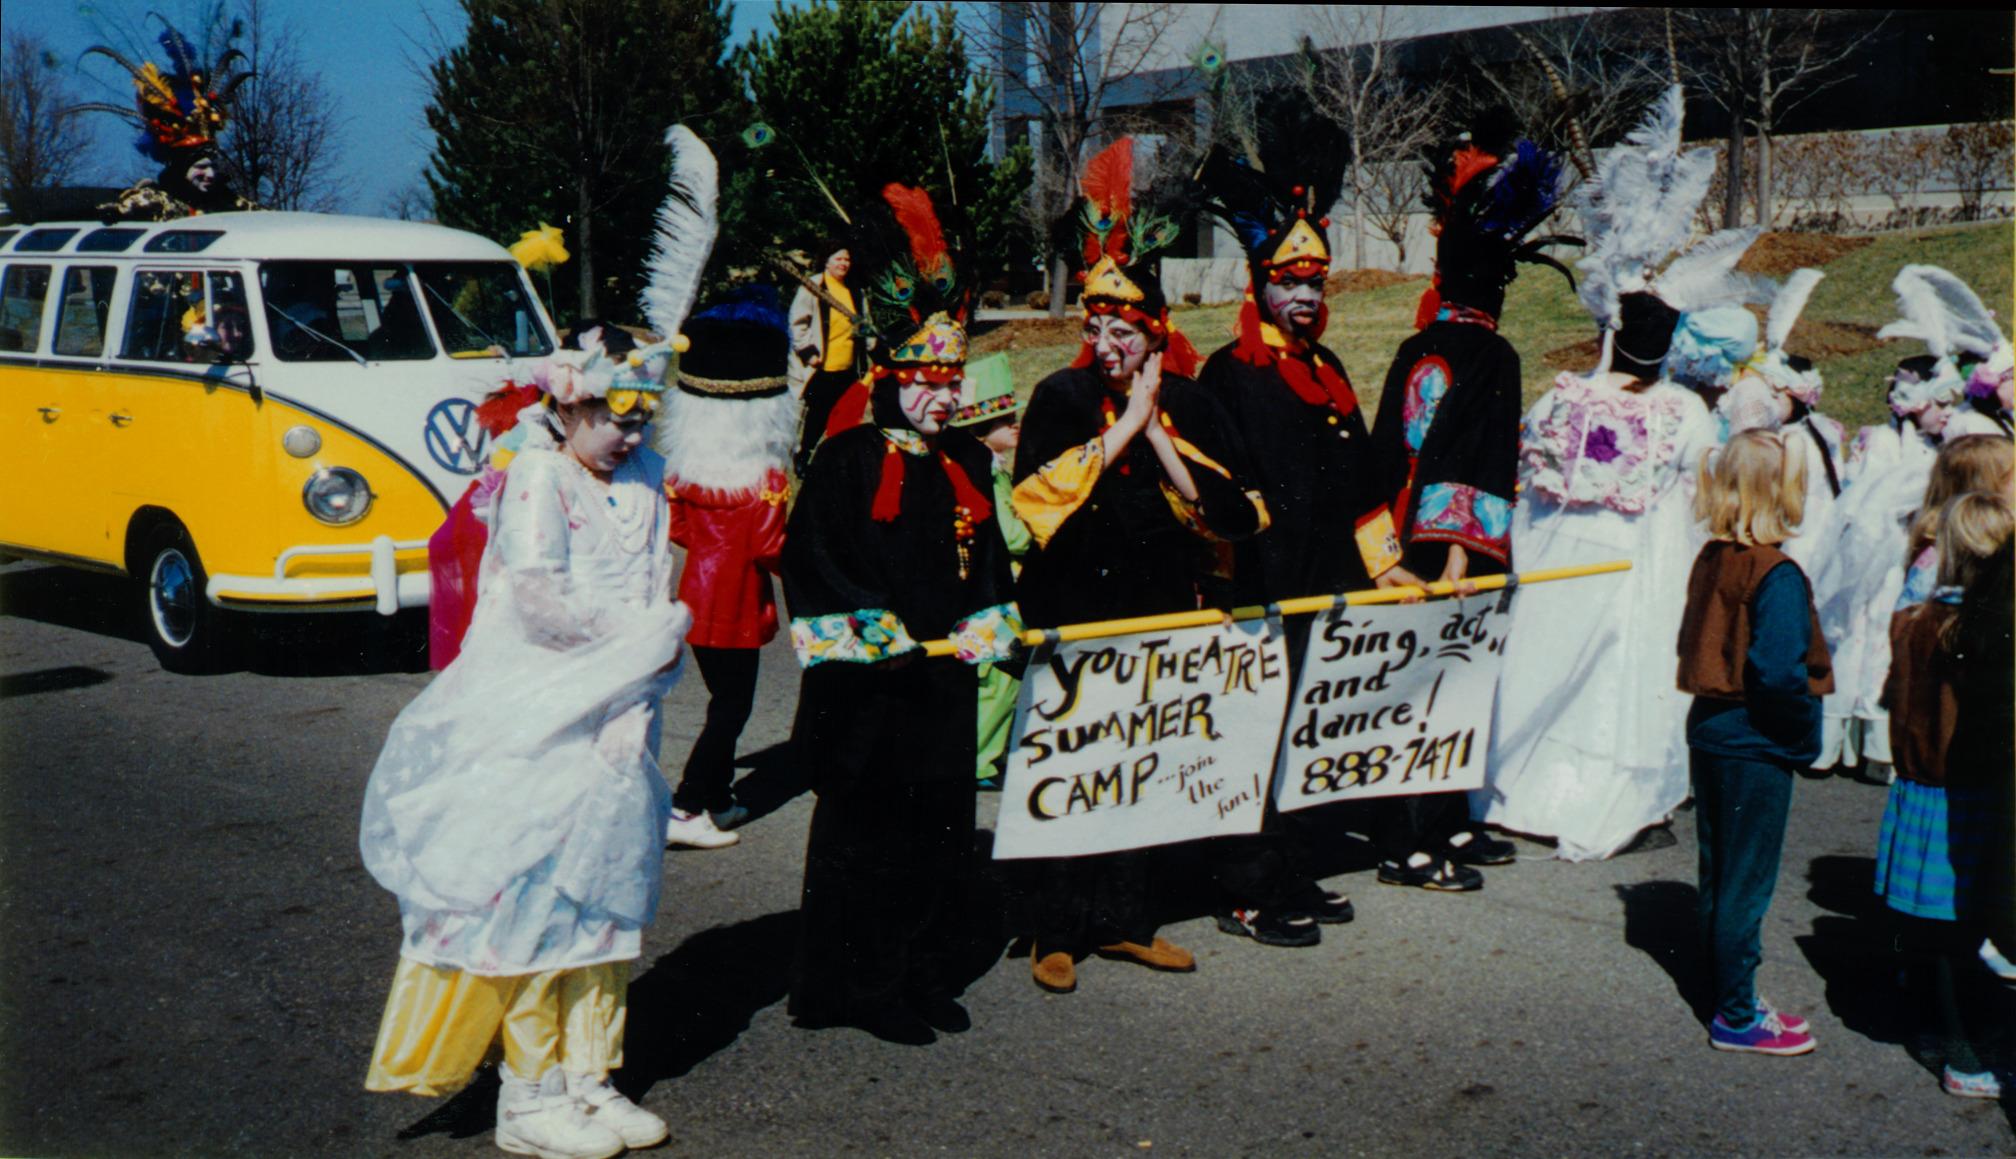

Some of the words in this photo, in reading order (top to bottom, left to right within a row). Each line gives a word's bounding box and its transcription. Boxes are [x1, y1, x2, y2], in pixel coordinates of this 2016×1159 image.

[424, 398, 489, 475] VW
[1026, 634, 1281, 721] YOUTHEATRE
[1321, 619, 1430, 672] Sing,
[1292, 669, 1445, 749] dance!
[1304, 661, 1390, 704] and
[1019, 692, 1224, 768] SUMMER
[1301, 727, 1475, 796] 888-7471
[1027, 752, 1159, 822] CAMP
[1187, 776, 1225, 805] the
[1214, 772, 1262, 820] fun!
